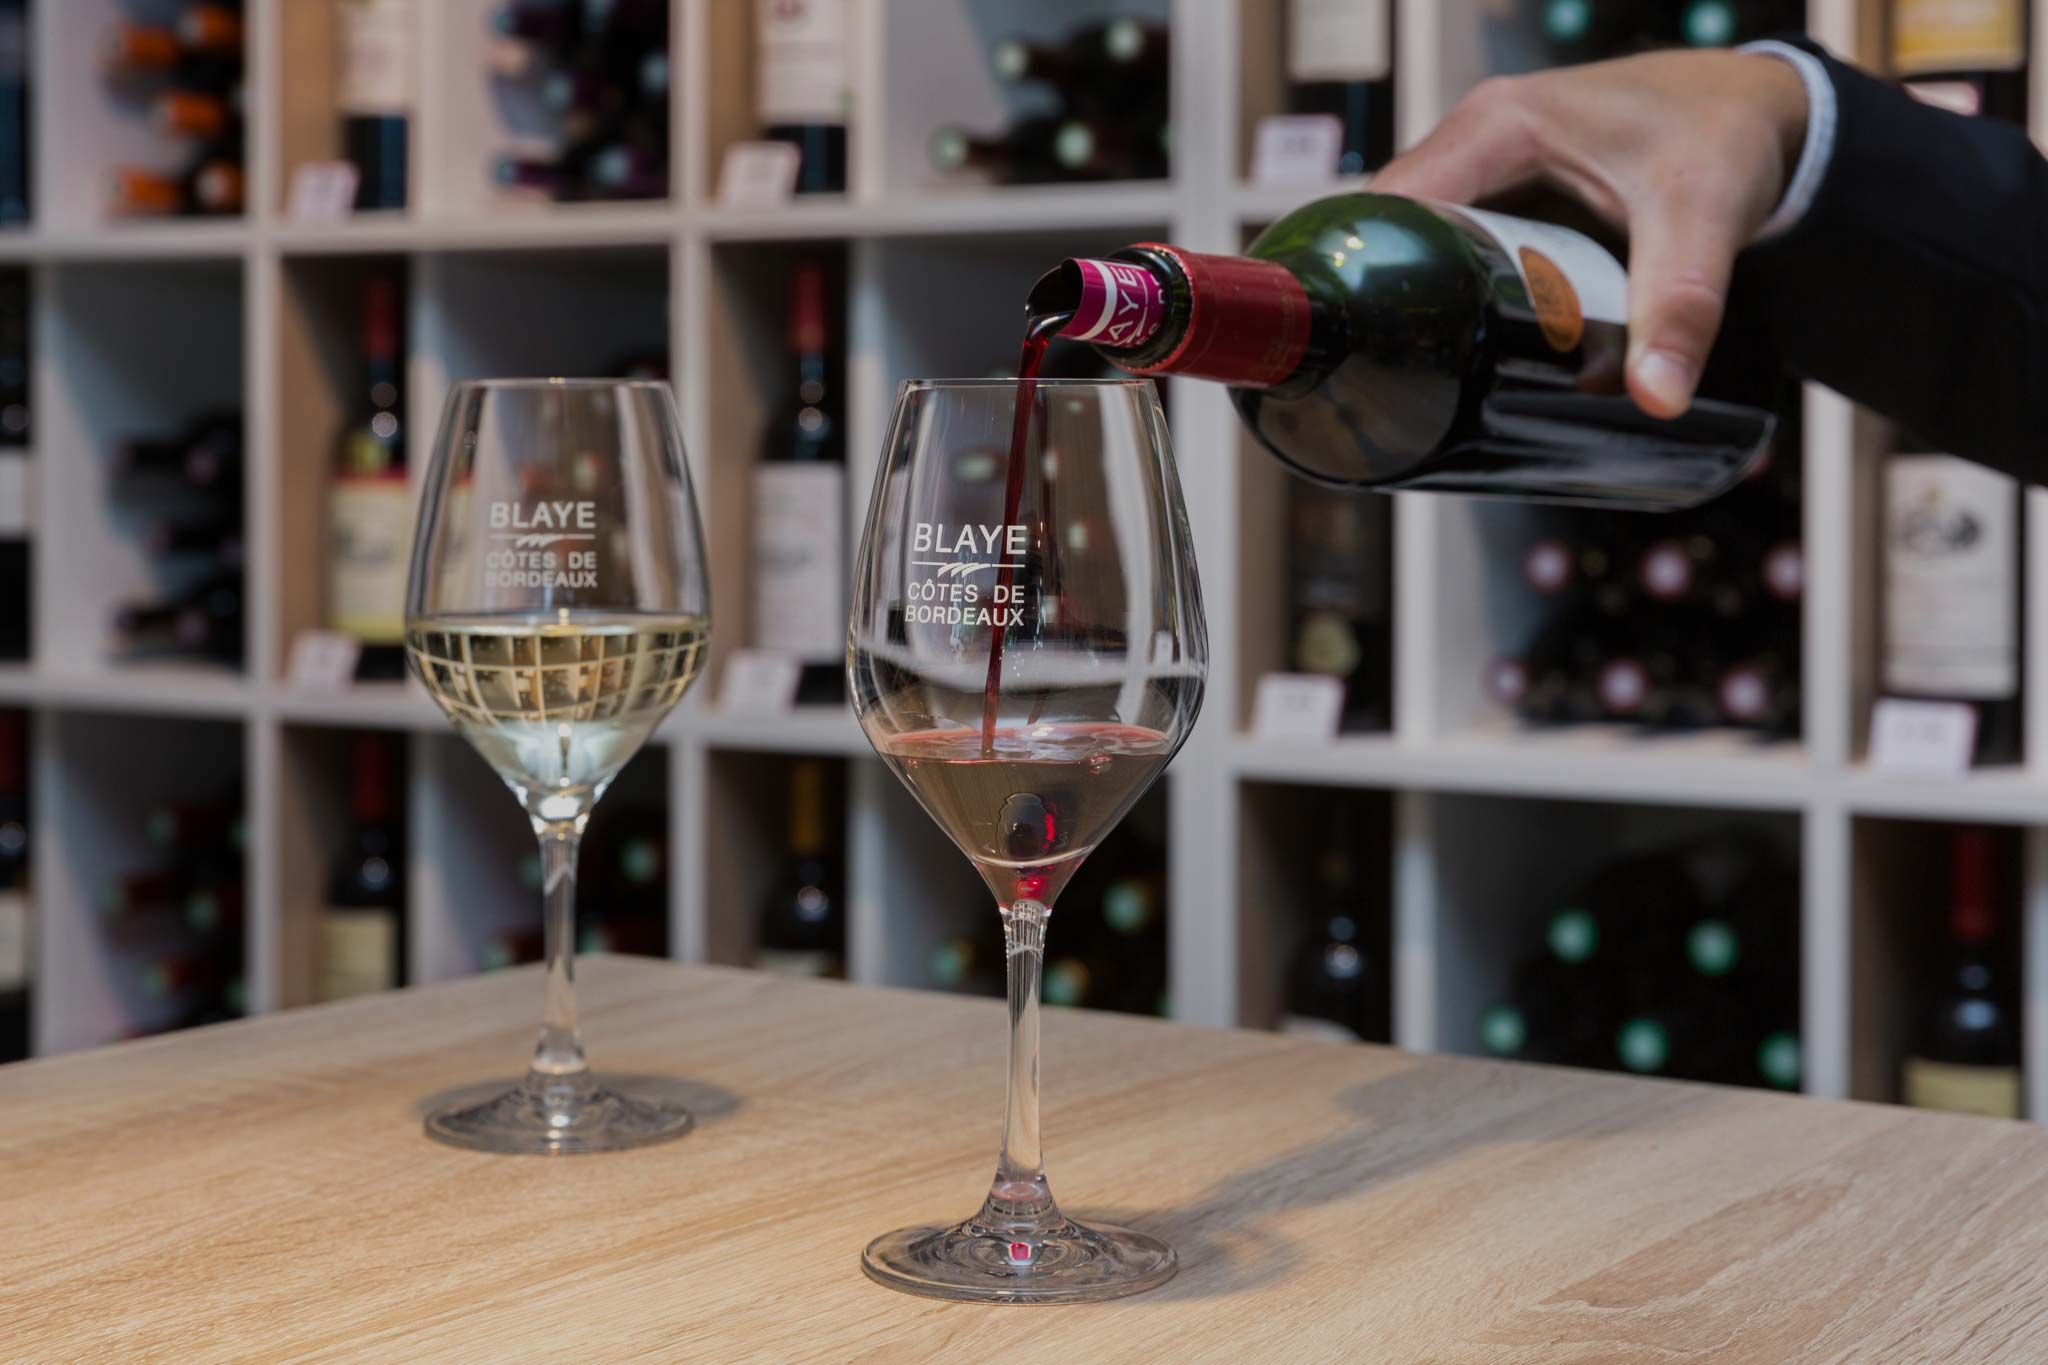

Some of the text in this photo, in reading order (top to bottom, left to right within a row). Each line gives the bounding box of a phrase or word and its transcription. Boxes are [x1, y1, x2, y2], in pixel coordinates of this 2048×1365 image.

[490, 502, 596, 528] BLAYE
[914, 523, 1027, 554] BLAYE
[486, 550, 597, 570] CÔTES DE
[485, 570, 598, 588] BORDEAUX
[907, 578, 1025, 604] CÔTES DE
[905, 605, 1024, 626] BORDEAUX
